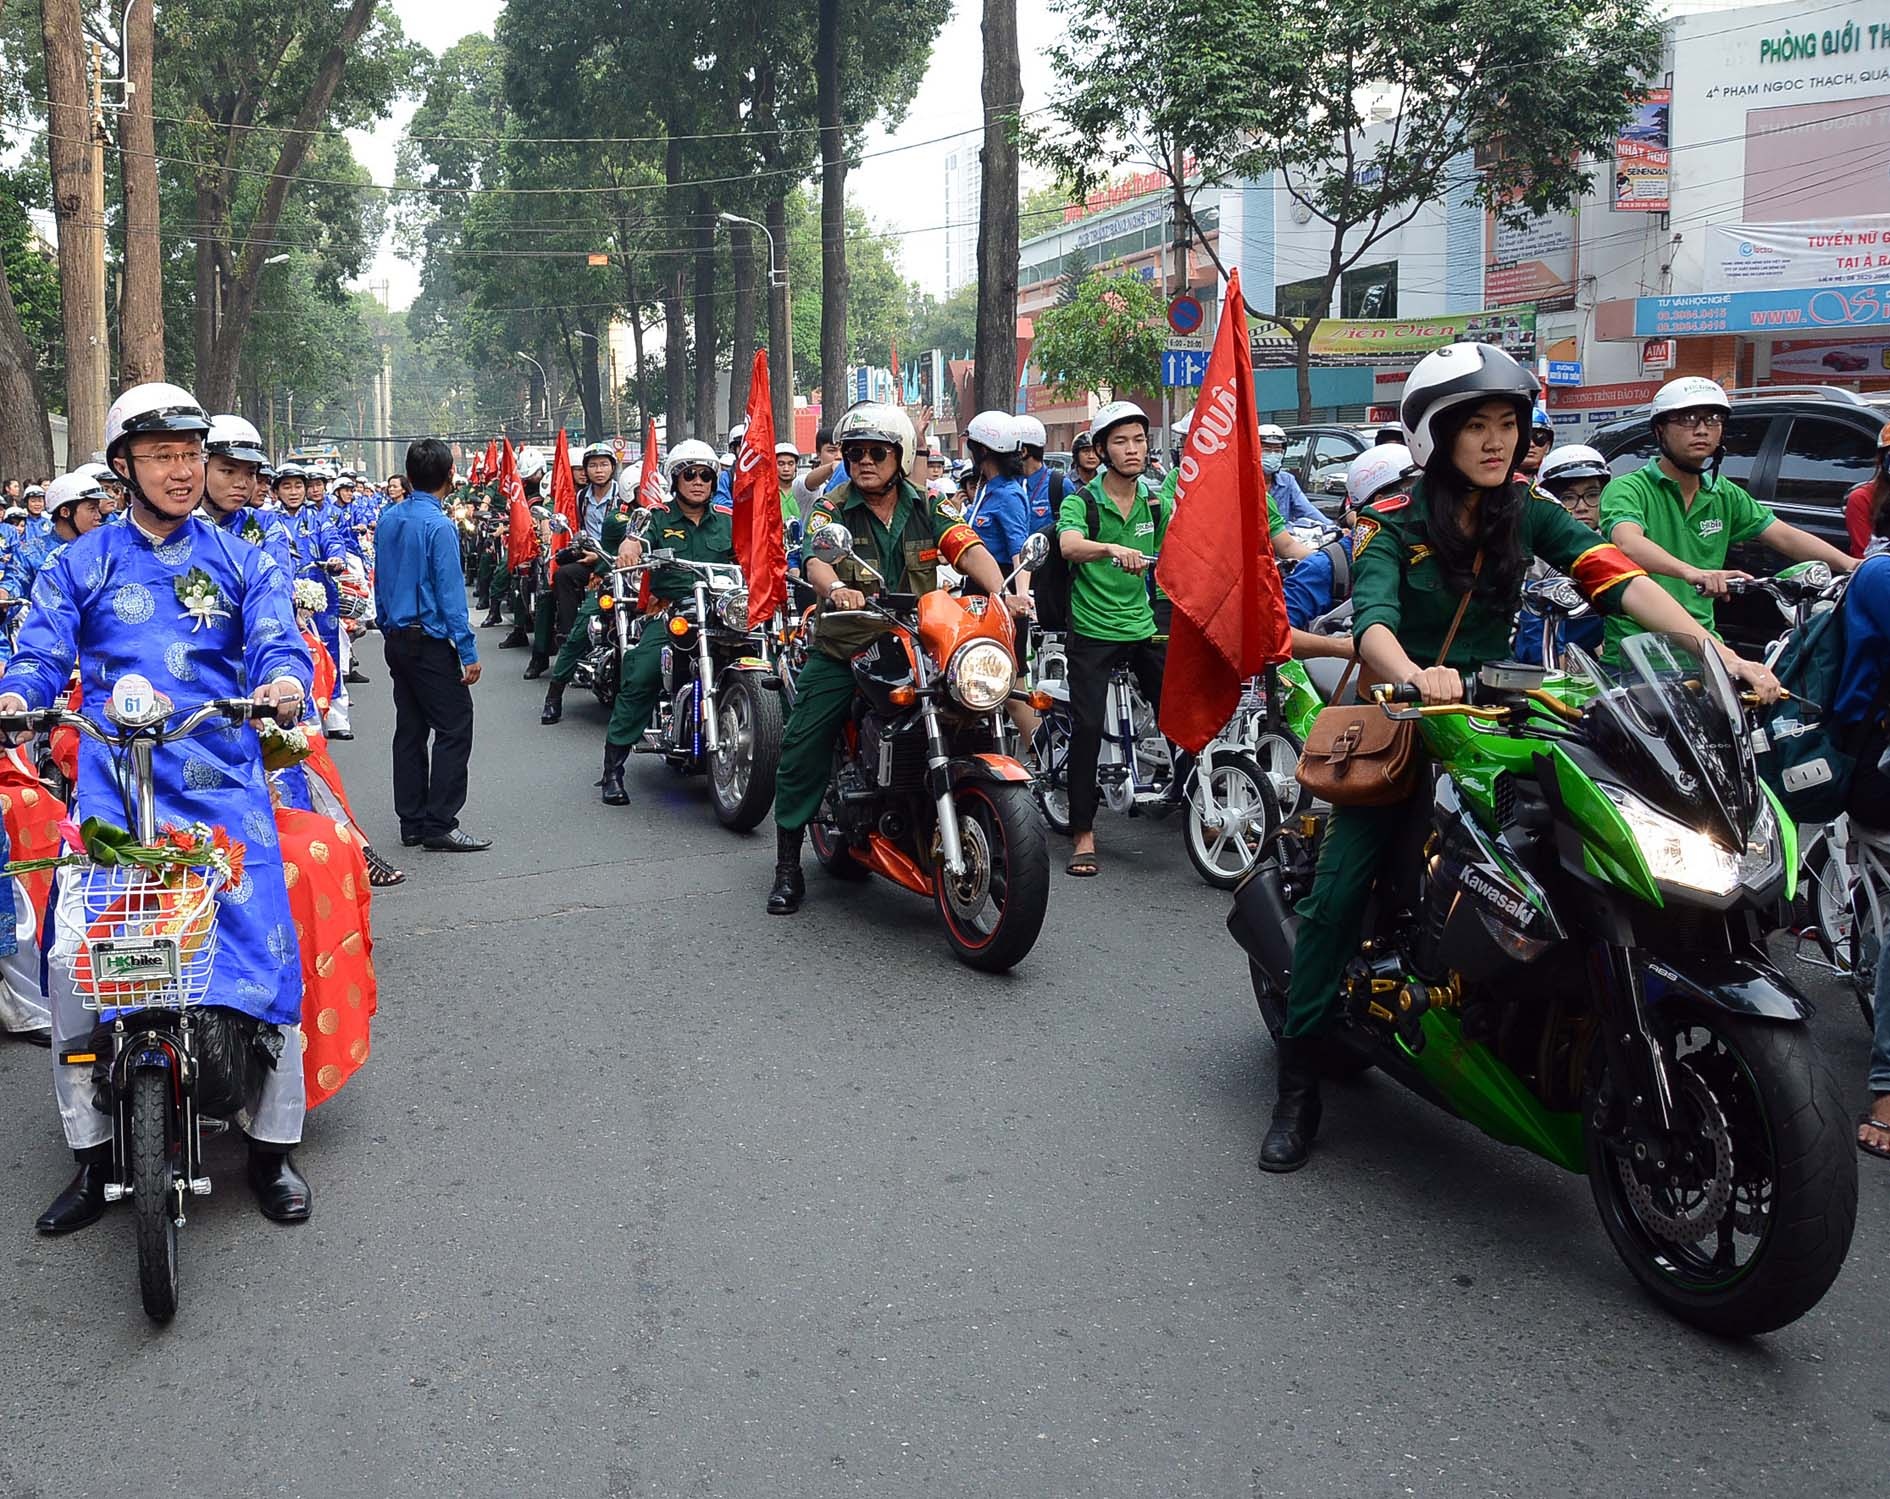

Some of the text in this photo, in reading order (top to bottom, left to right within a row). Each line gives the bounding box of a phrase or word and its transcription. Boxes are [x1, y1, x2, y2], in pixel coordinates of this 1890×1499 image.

[1760, 29, 1816, 64] PHÒNG
[1822, 20, 1860, 56] GIỚI
[1645, 344, 1667, 357] ATM
[125, 697, 141, 713] 61
[1459, 865, 1537, 929] Kawasaki
[106, 954, 163, 968] HKbike
[1648, 963, 1678, 982] ABS
